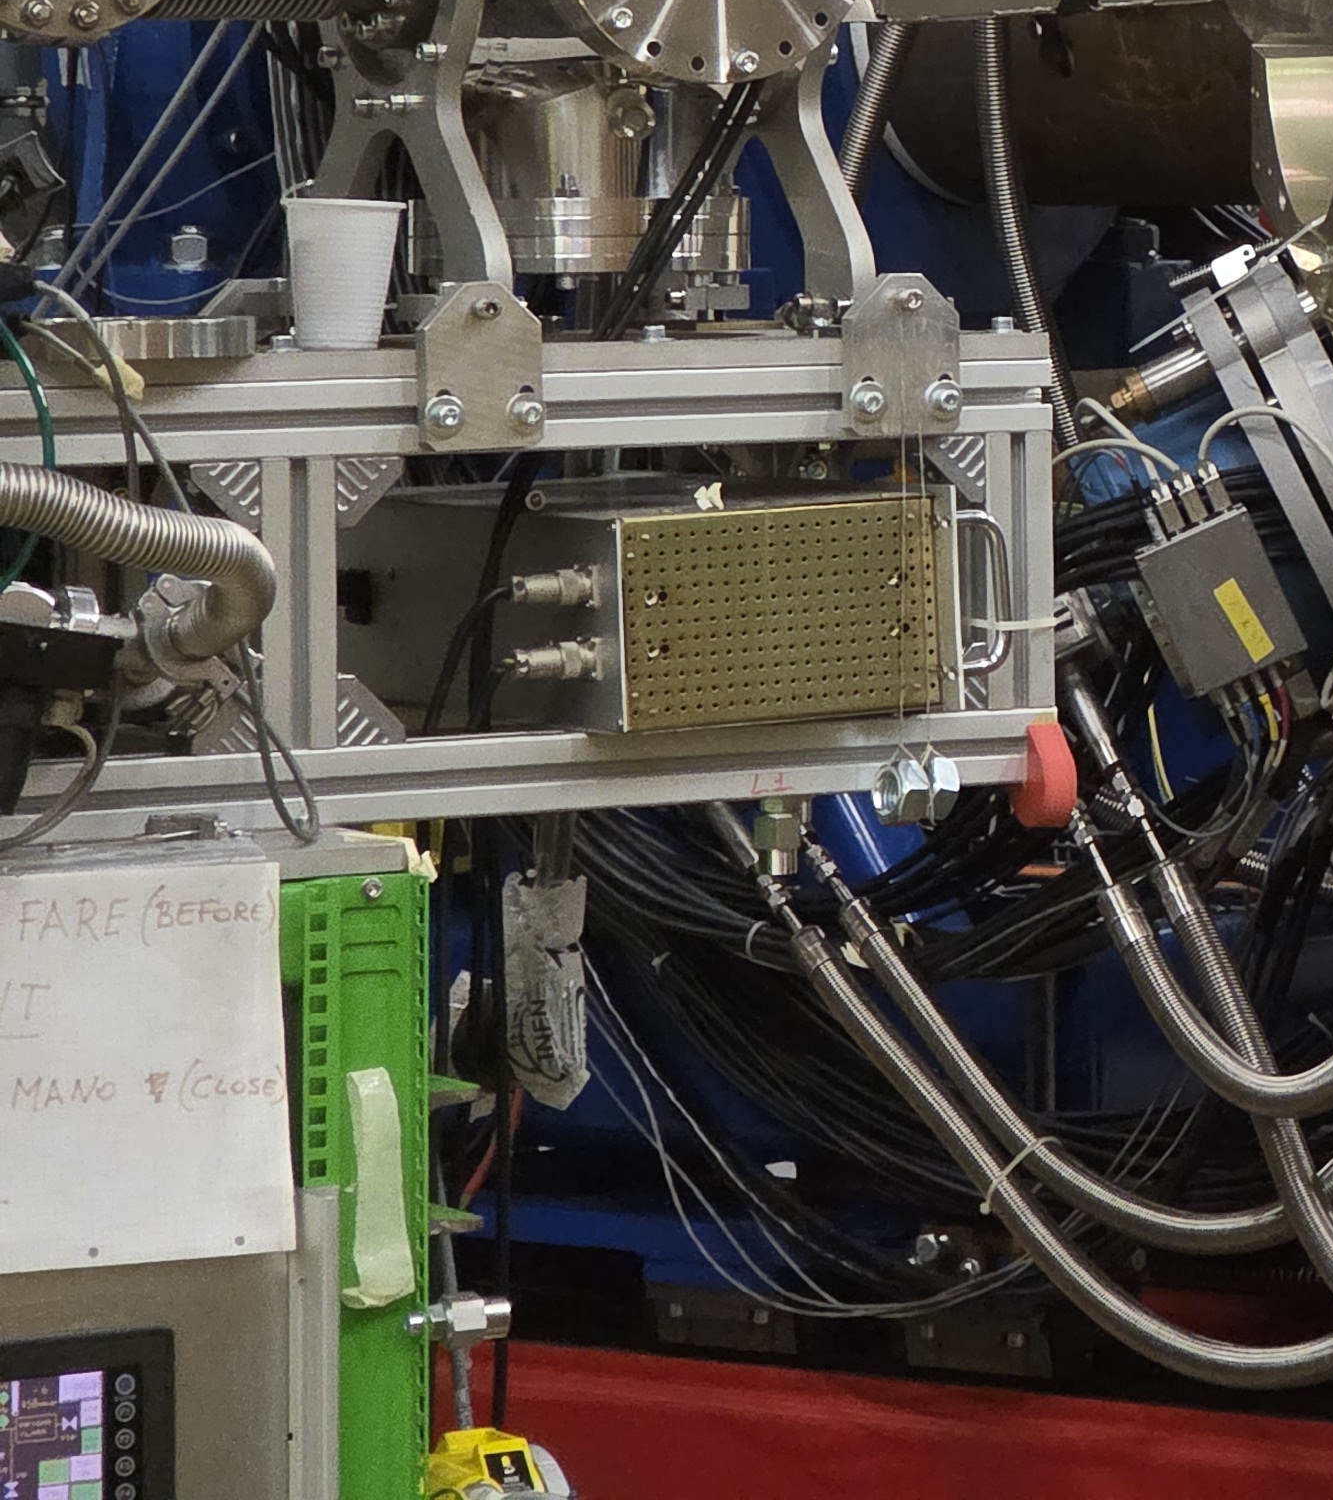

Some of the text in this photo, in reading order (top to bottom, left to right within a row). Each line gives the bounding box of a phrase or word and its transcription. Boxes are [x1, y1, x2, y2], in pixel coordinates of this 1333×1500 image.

[18, 897, 129, 942] FARE
[531, 999, 555, 1060] INFN
[11, 1076, 117, 1112] MANO
